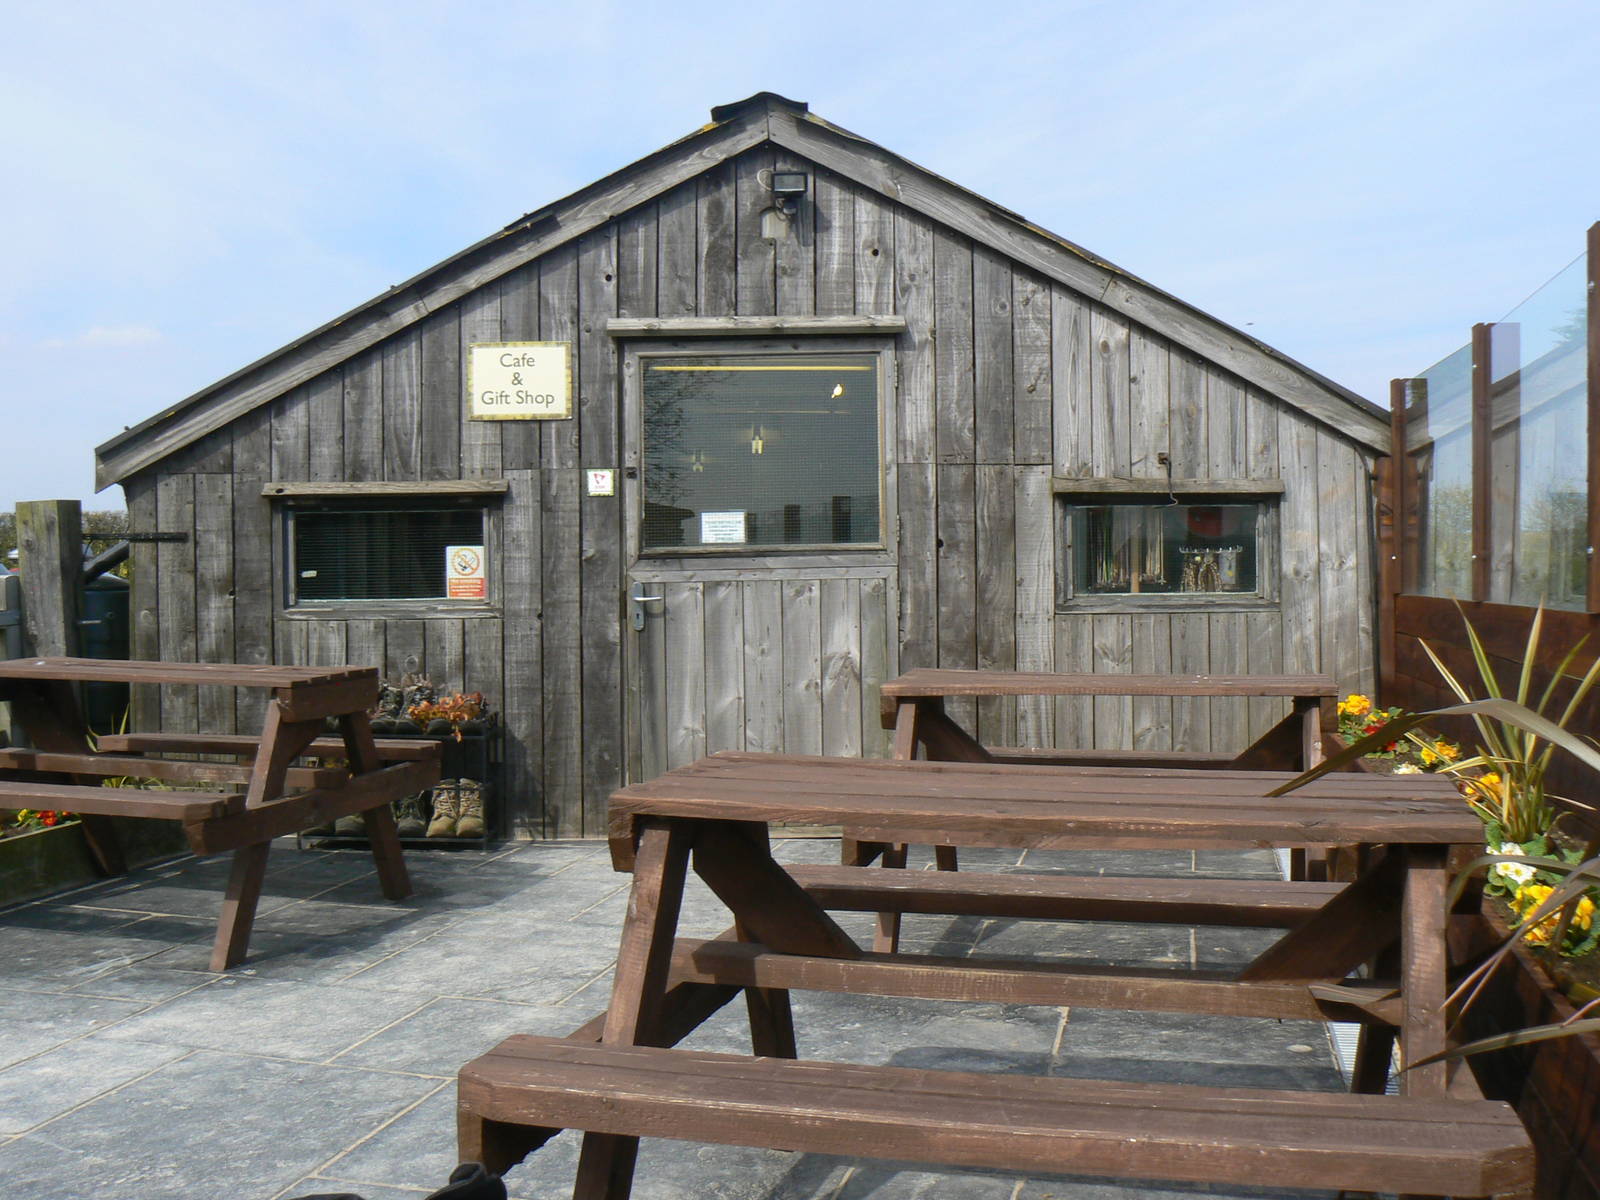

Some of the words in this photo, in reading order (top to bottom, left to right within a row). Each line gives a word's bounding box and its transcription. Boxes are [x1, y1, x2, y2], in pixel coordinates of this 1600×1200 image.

[499, 353, 535, 368] Cafe
[511, 371, 523, 386] &
[481, 390, 511, 405] Gift
[515, 390, 555, 409] Shop
